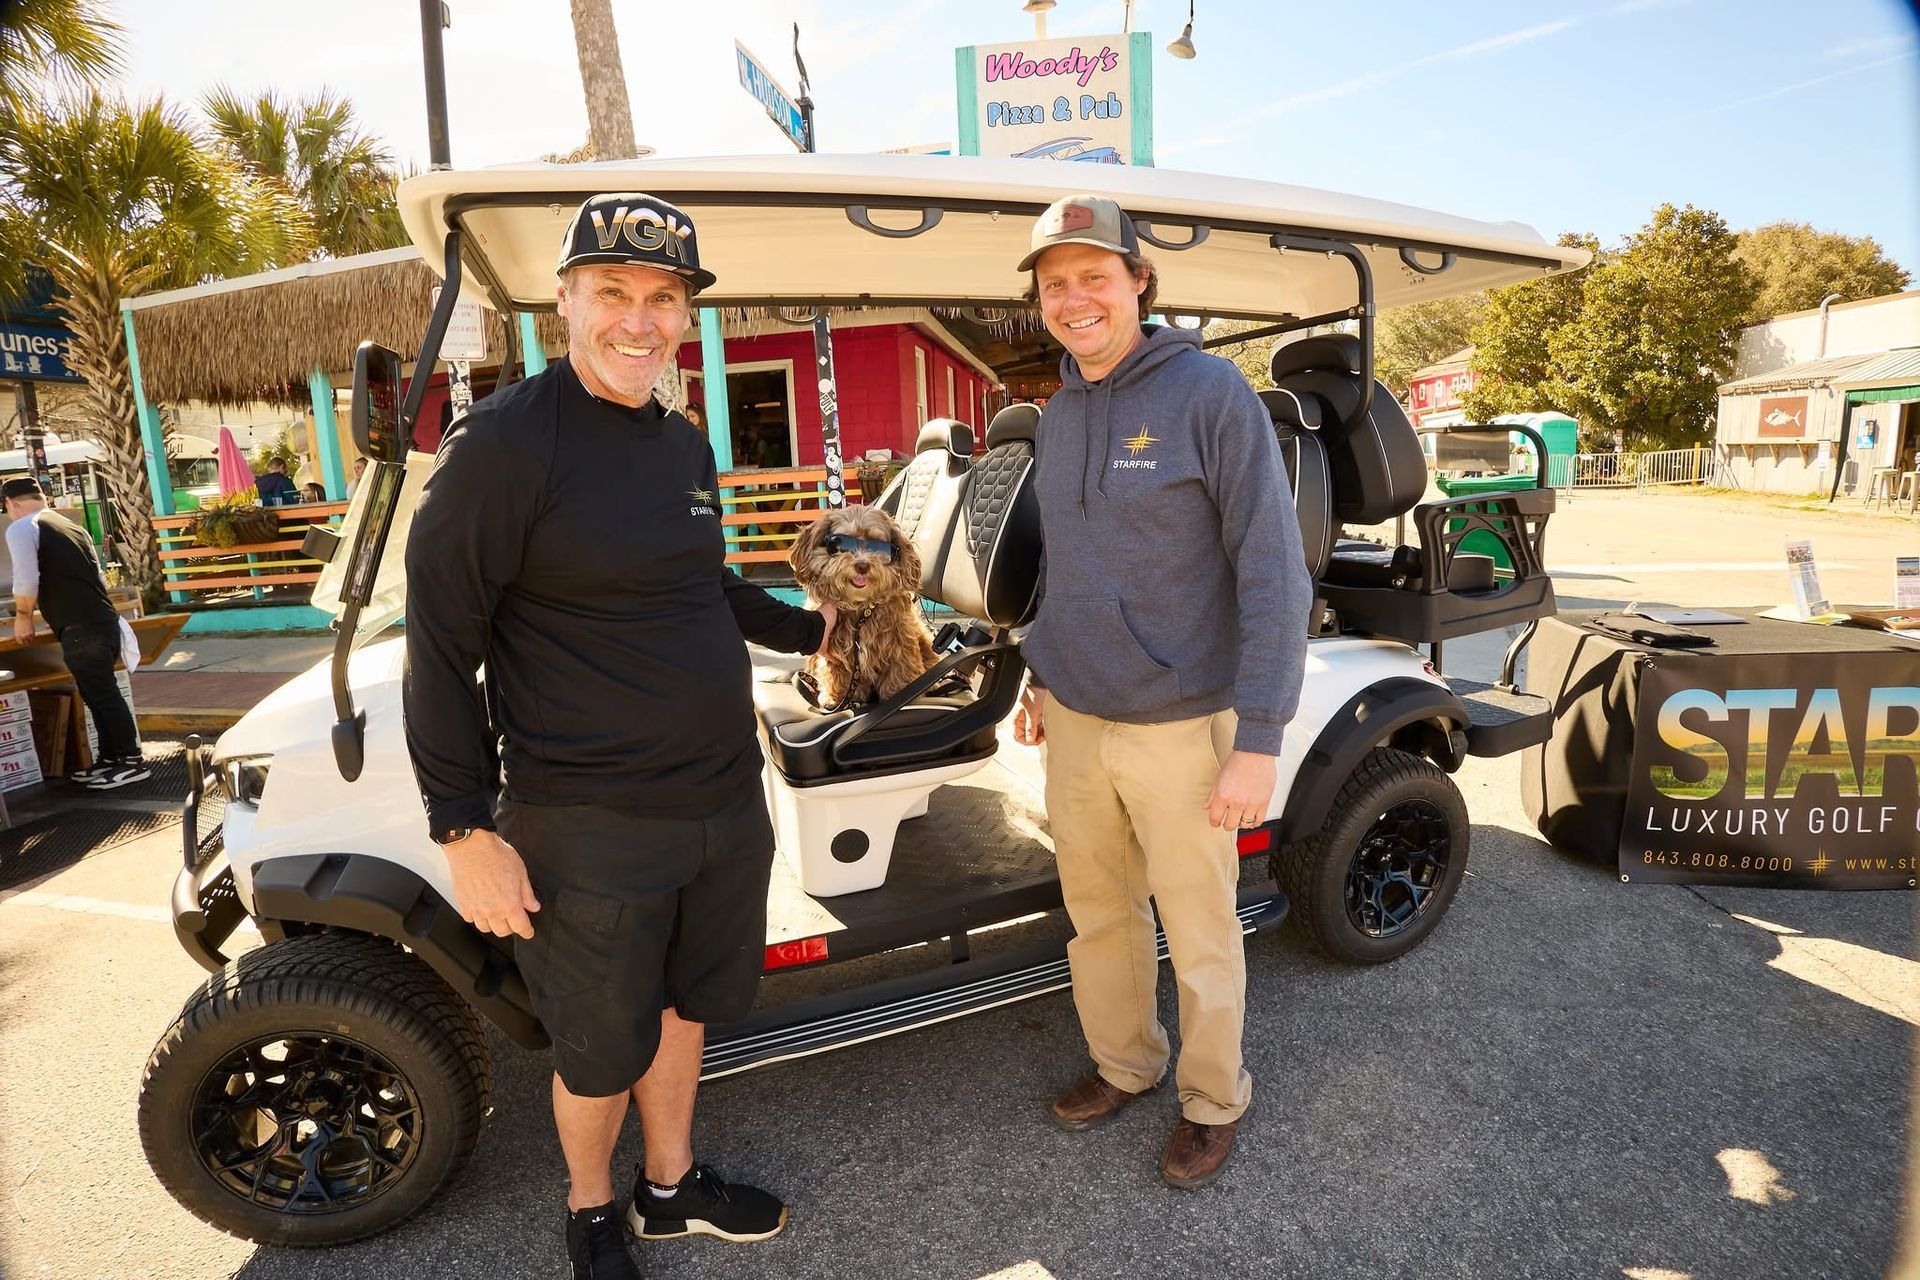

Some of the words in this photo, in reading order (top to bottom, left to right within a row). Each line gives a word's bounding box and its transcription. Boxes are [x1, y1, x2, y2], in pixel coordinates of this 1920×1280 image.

[986, 46, 1119, 87] Woody's
[750, 63, 793, 134] HUDSON
[987, 101, 1045, 128] Pizza
[1053, 96, 1072, 121] &
[1080, 92, 1122, 120] Pub
[590, 206, 692, 264] VGK
[819, 394, 835, 413] PULP
[1113, 460, 1158, 470] STARFIRE
[1650, 686, 1920, 800] STAR
[1646, 806, 1790, 835] LUXURY
[1808, 806, 1897, 834] GOLF
[1643, 850, 1793, 872] 843.808.8000
